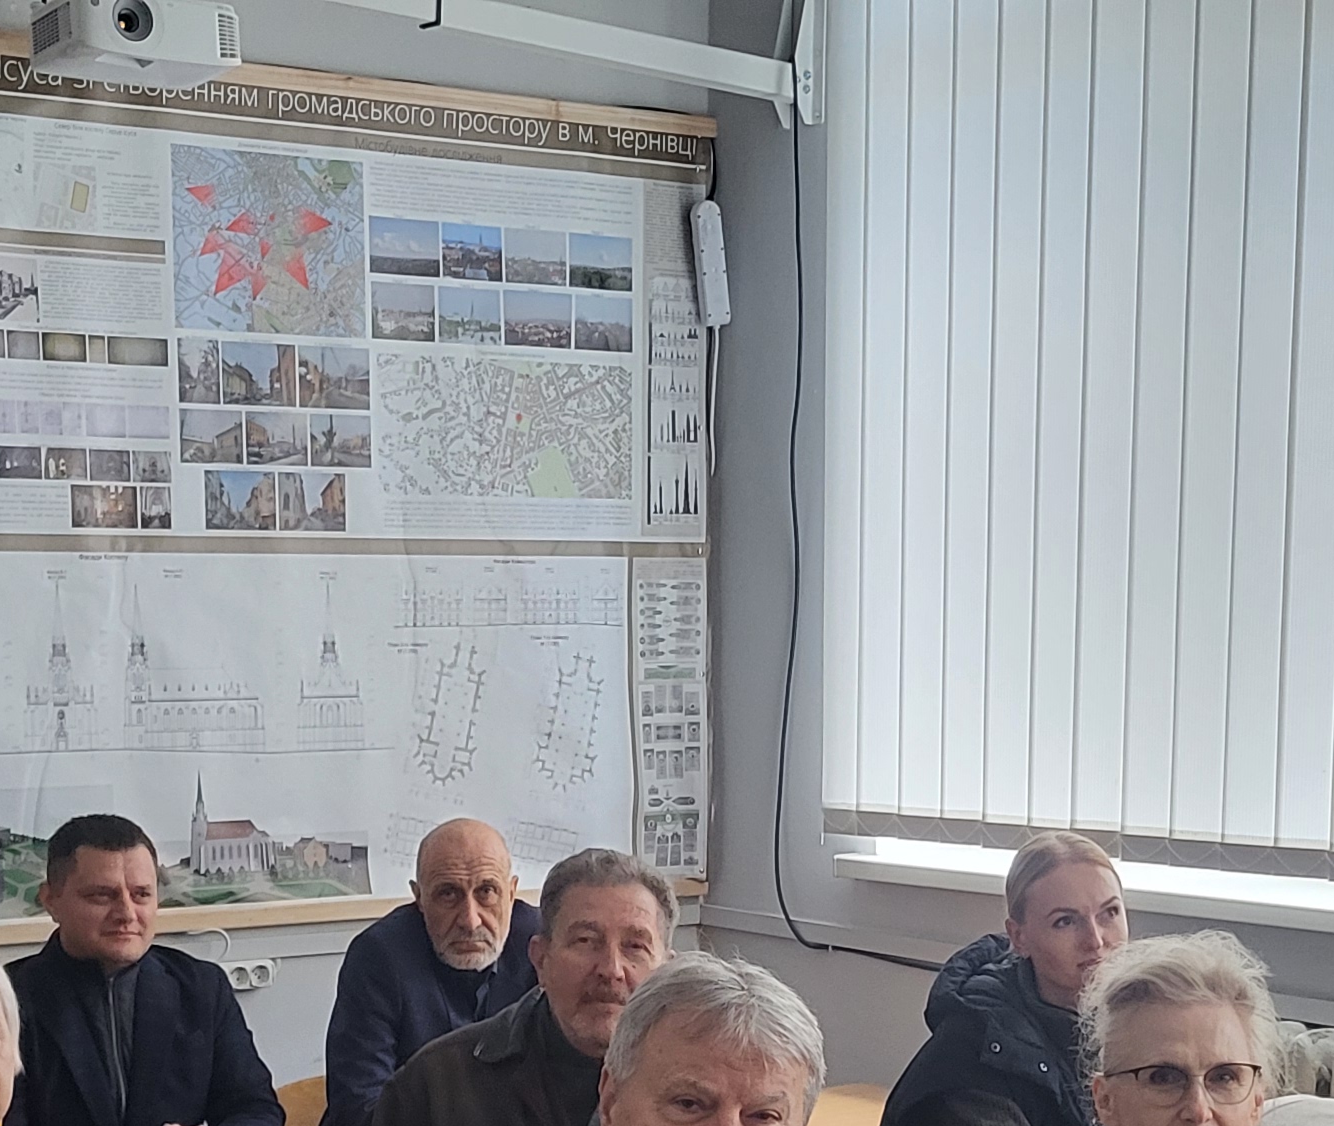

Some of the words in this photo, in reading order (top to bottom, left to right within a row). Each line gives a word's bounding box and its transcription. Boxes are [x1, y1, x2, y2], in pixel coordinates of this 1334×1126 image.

[267, 89, 435, 127] громадського
[443, 110, 552, 145] простору
[558, 123, 570, 141] в
[577, 126, 598, 145] м.
[607, 125, 701, 161] Чернівці
